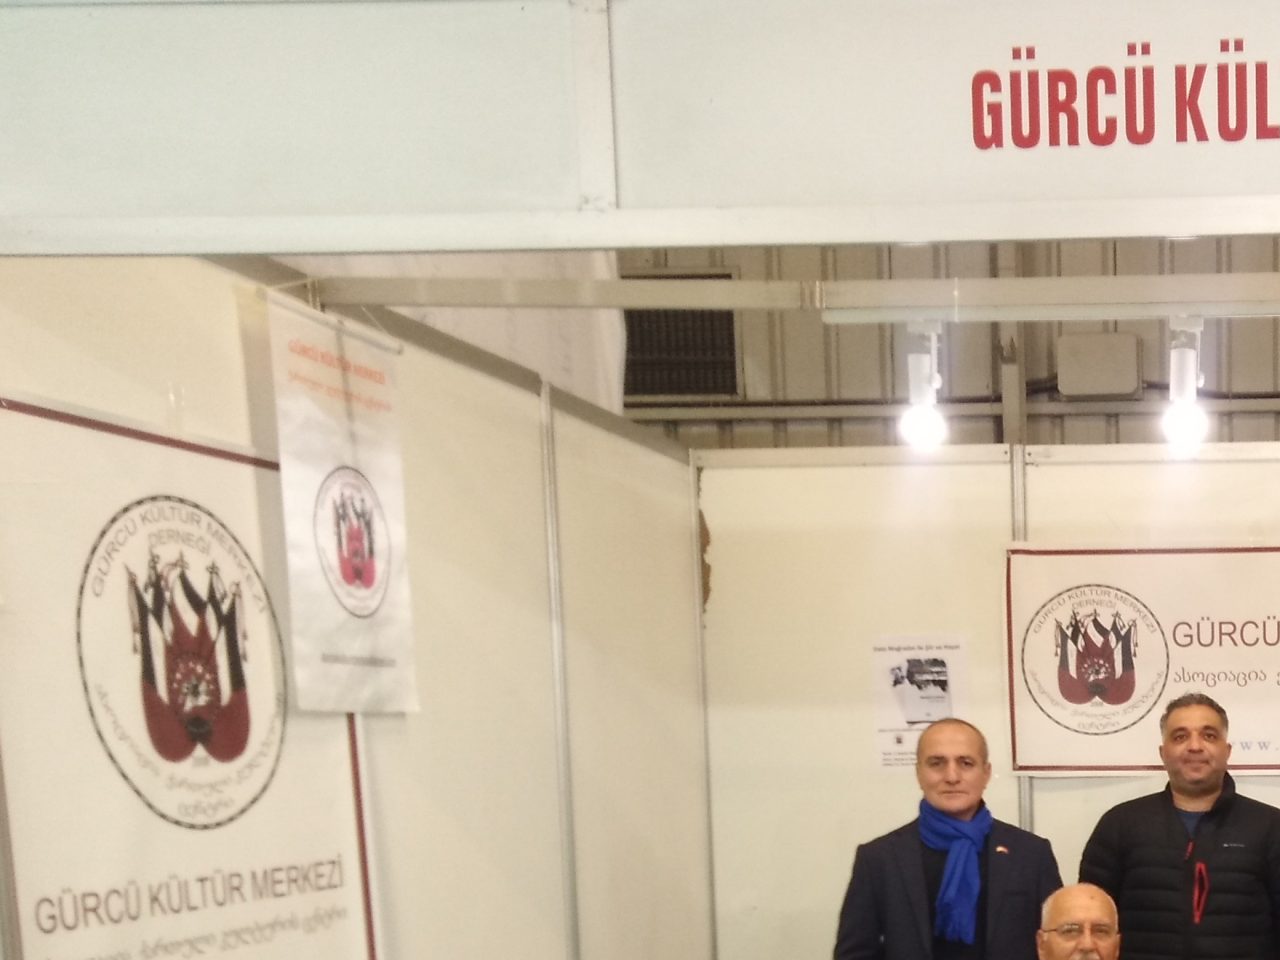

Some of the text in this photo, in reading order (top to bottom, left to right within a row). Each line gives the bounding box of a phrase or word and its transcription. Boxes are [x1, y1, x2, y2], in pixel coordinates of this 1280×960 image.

[970, 42, 1155, 151] GÜRCÜ
[1172, 615, 1280, 648] GÜRCÜ
[1173, 666, 1268, 688] ასოციაცია
[34, 852, 345, 936] GÜRCÜ KÜLTÜR MERKEZİ
